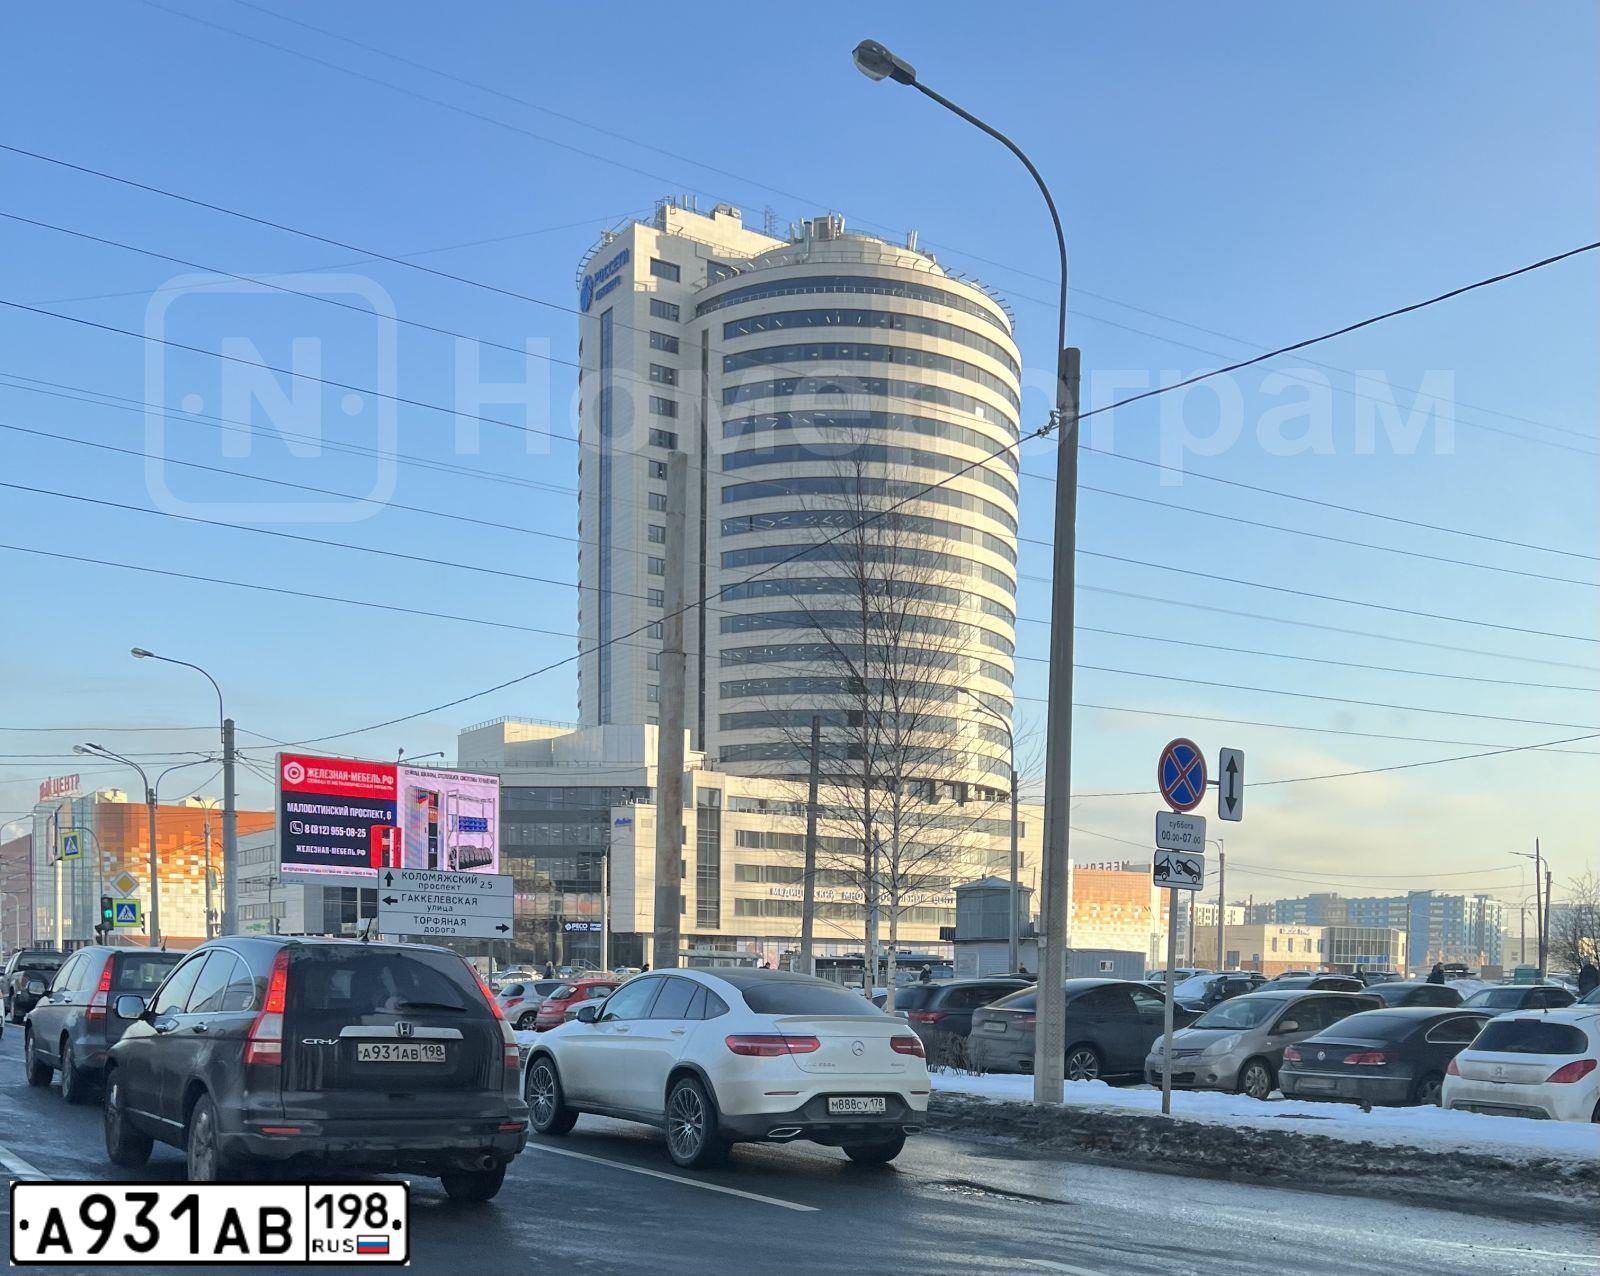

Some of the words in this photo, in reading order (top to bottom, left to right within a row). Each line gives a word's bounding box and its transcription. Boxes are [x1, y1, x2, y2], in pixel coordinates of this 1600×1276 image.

[306, 767, 394, 785] ЖЕЛЕЗНАЯ-МЕБЕЛЬ.РФ
[287, 802, 348, 817] МАЛООХТИНСКИЙ
[349, 807, 386, 820] ПРОСПЕКТ,
[304, 824, 310, 834] 8
[311, 824, 330, 835] (812)
[1169, 821, 1194, 830] суббота
[401, 872, 478, 884] КОЛОМЯЖСКИЙ
[418, 882, 461, 891] проспект
[401, 893, 478, 905] ГАККЕЛЕВСКАЯ
[413, 916, 467, 926] ТОРФЯНАЯ
[423, 926, 456, 934] дорога
